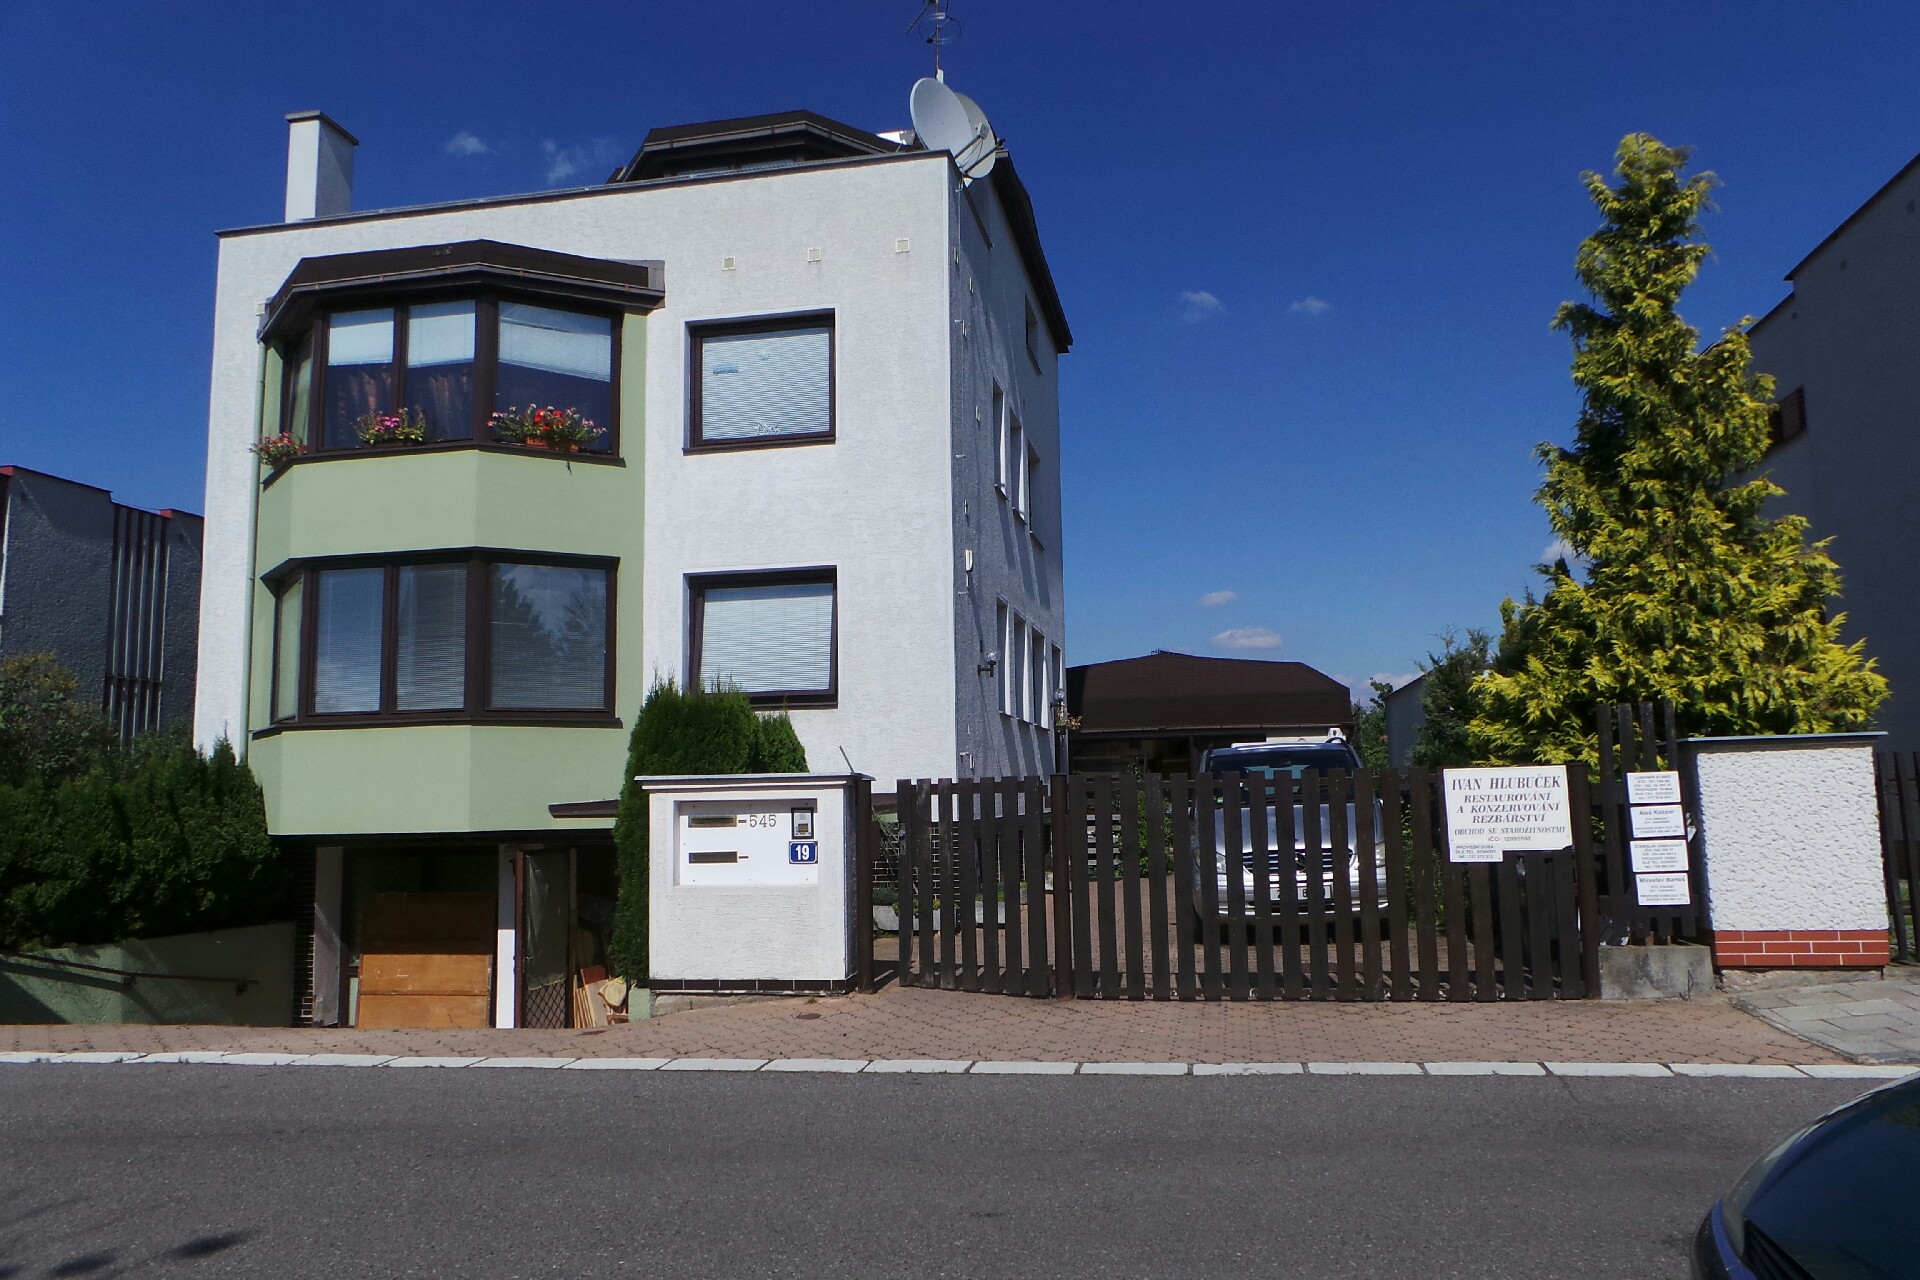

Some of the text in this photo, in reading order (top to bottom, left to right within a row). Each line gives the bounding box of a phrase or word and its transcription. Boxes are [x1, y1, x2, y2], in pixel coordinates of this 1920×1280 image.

[1451, 774, 1561, 791] IVAN HLUBUČEK
[1464, 791, 1552, 803] RESTAUROVÁNÍ
[1456, 801, 1560, 814] A KONZERVOVÁNÍ
[749, 814, 777, 828] 545
[1472, 812, 1546, 824] ŘEZBÁŘSTVÍ
[1454, 828, 1485, 836] OBCHOD
[1501, 826, 1566, 835] STAROŽITNOSTMI
[795, 844, 810, 861] 19
